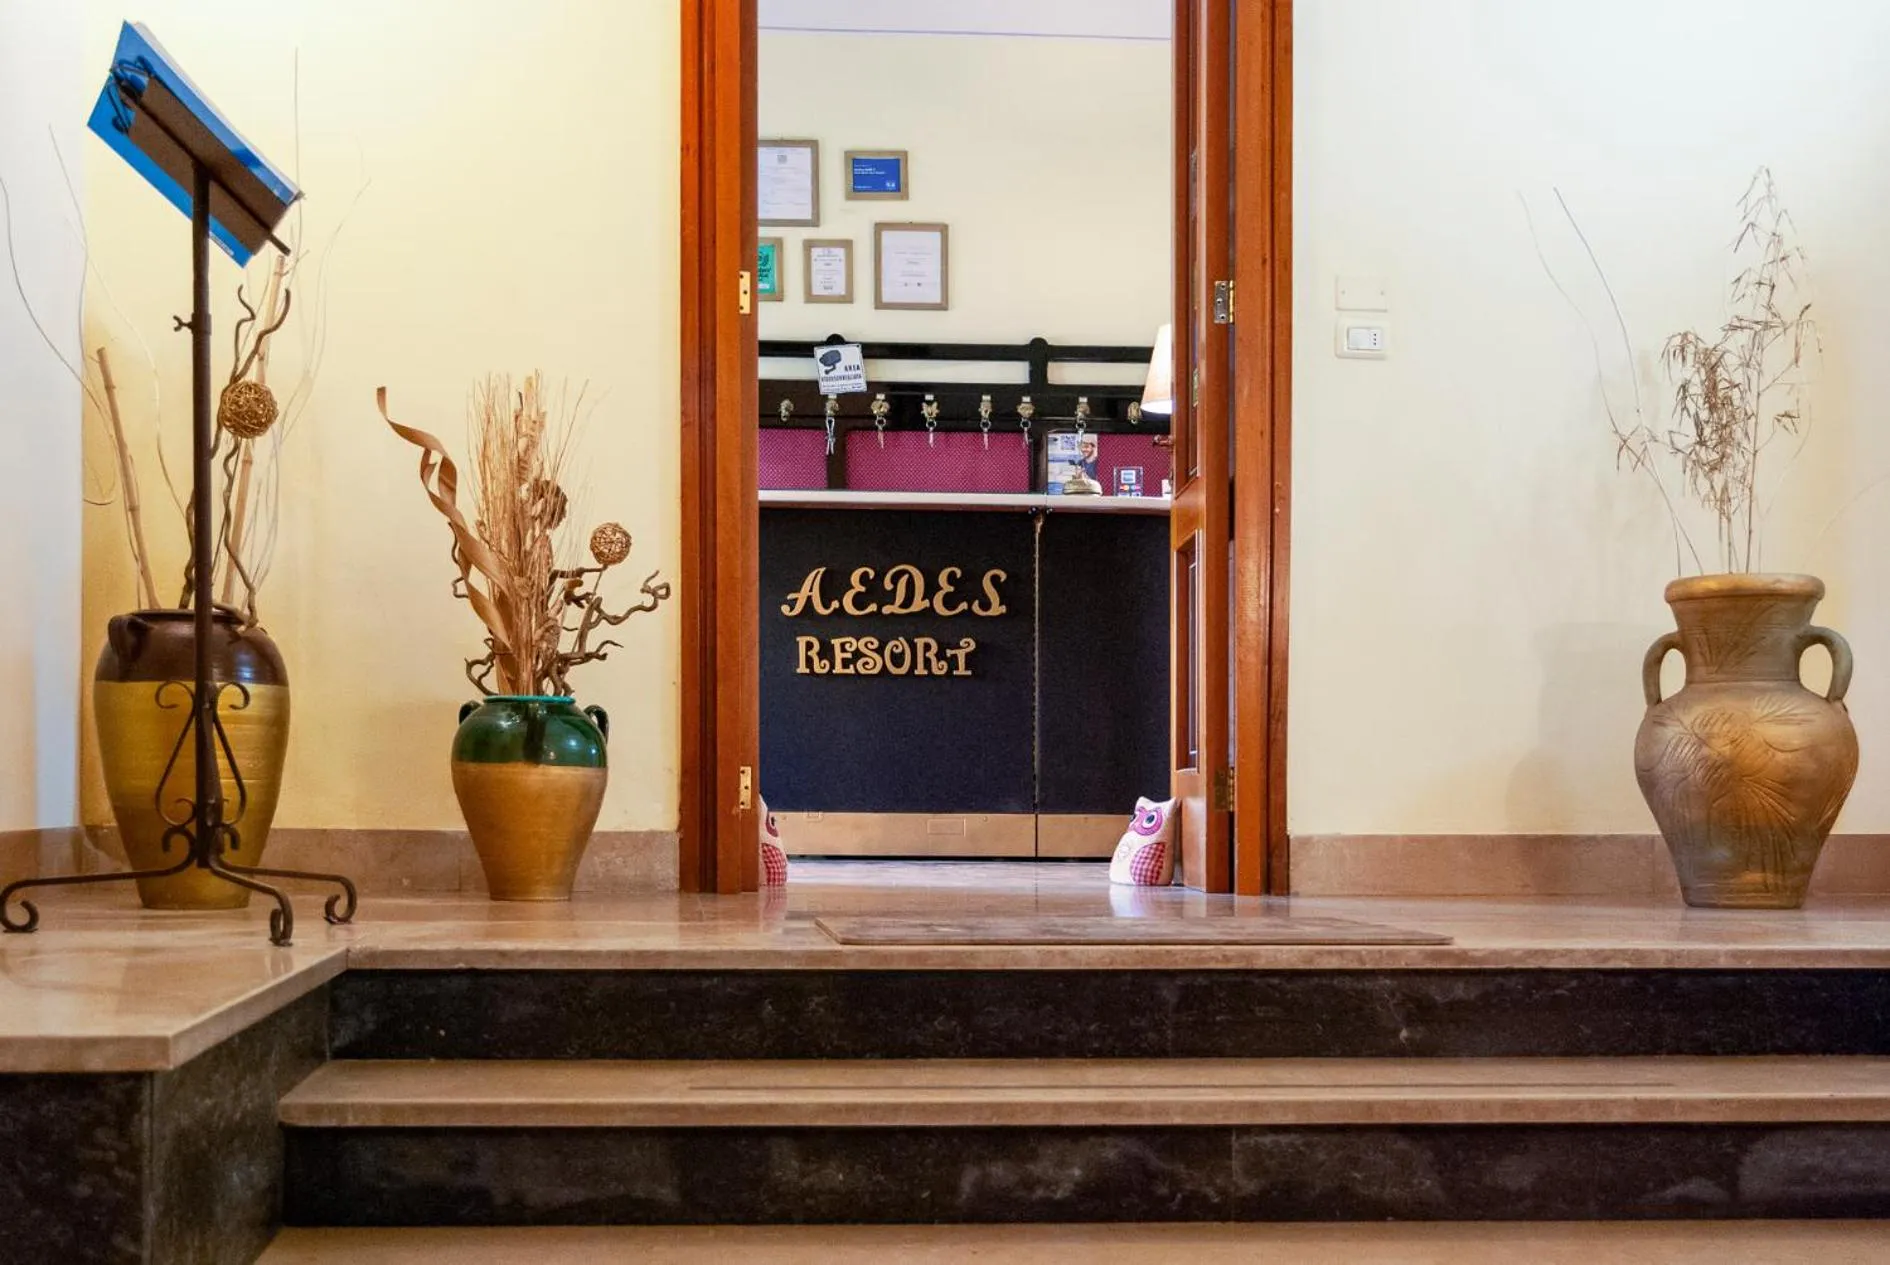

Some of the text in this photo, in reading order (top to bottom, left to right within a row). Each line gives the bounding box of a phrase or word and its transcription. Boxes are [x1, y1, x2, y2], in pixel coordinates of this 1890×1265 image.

[844, 364, 861, 372] AREA
[780, 564, 1008, 617] AEDES
[795, 635, 977, 676] RESORT
